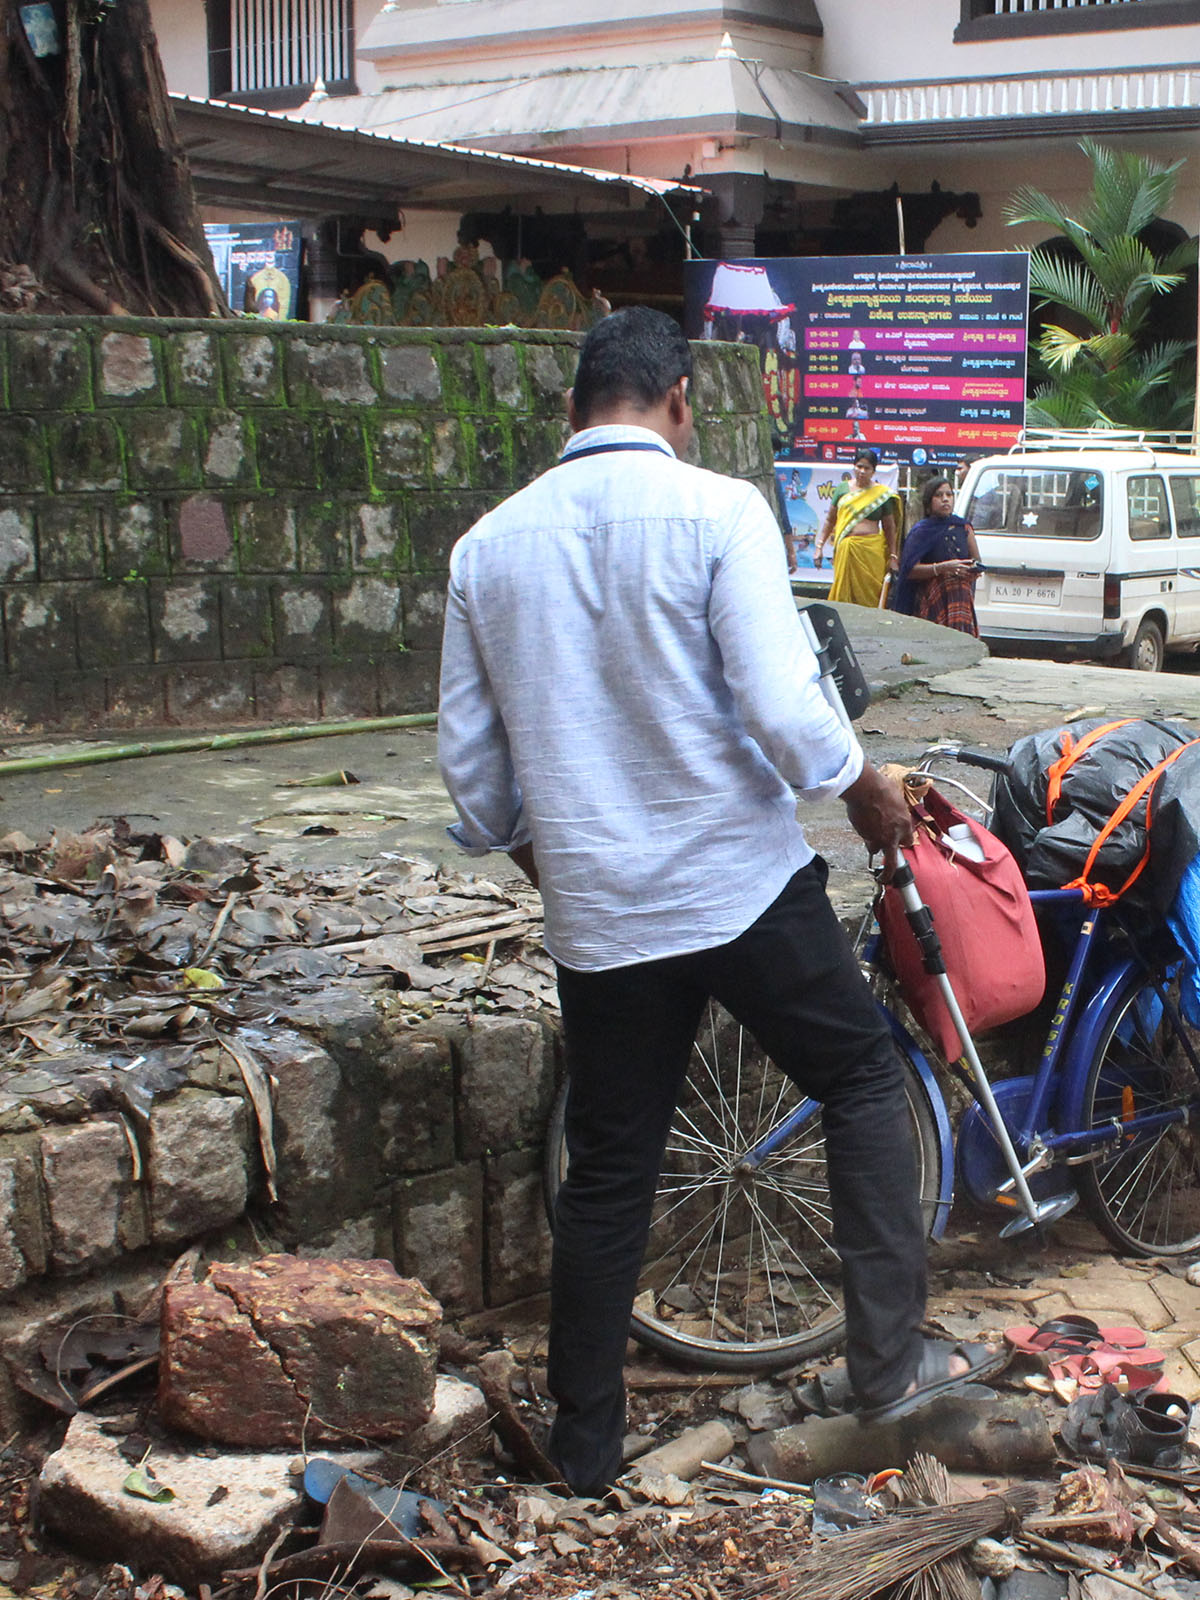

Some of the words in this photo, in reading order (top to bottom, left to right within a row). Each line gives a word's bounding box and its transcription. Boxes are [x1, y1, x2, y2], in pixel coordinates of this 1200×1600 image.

[996, 586, 1008, 596] KA
[1012, 587, 1022, 597] 20
[1026, 588, 1032, 598] P
[1036, 589, 1056, 598] 6676
[1043, 982, 1075, 1057] KROSS
